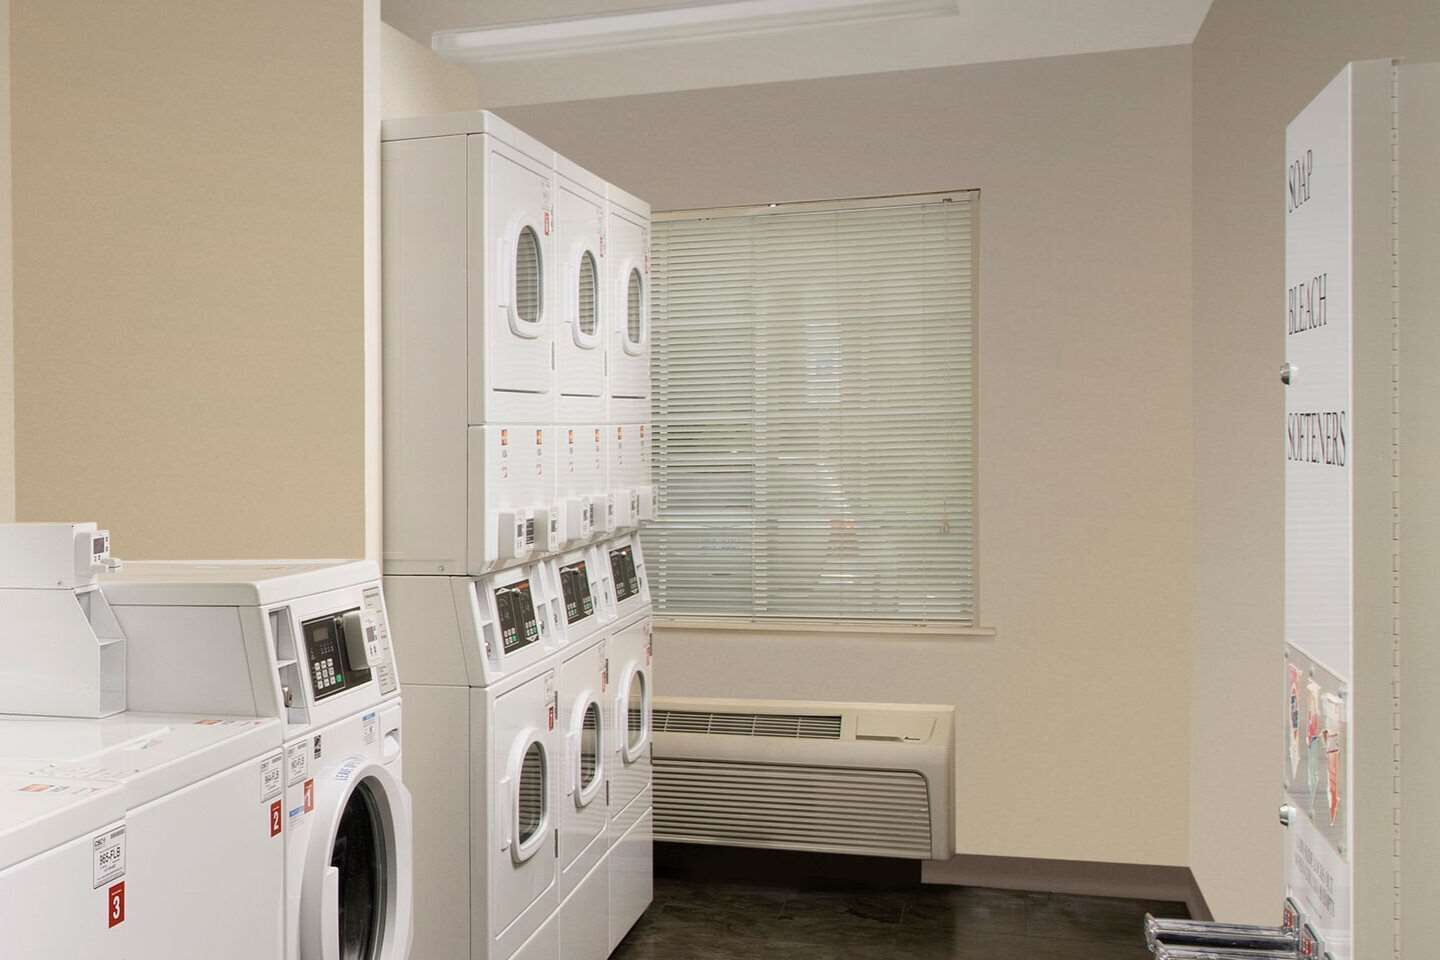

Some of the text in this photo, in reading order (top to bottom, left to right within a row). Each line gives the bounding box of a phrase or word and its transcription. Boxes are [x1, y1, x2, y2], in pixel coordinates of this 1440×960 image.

[1289, 149, 1313, 214] SOAP
[1288, 272, 1327, 336] BLEACH
[305, 787, 312, 808] 1
[273, 810, 279, 831] 2
[113, 895, 121, 920] 3
